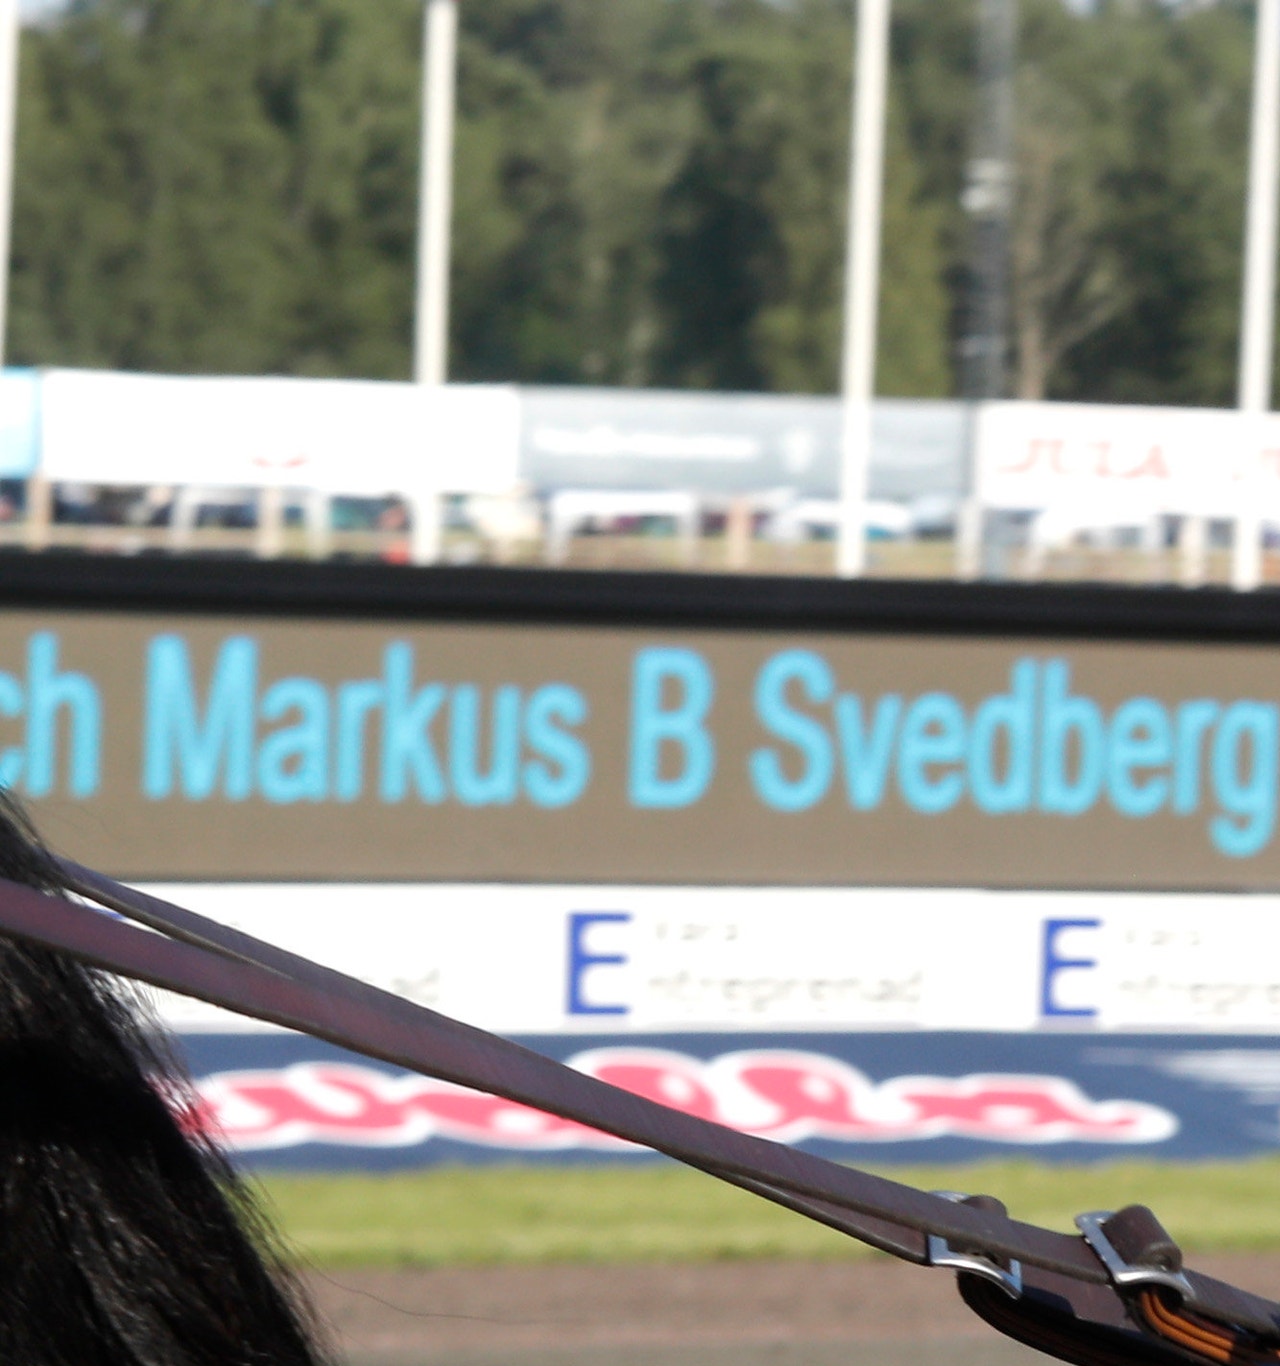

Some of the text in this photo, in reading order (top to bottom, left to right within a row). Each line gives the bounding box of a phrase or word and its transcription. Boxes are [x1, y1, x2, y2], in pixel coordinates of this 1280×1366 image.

[144, 633, 588, 807] Markus
[629, 646, 714, 809] B
[749, 647, 1280, 860] Svedberg
